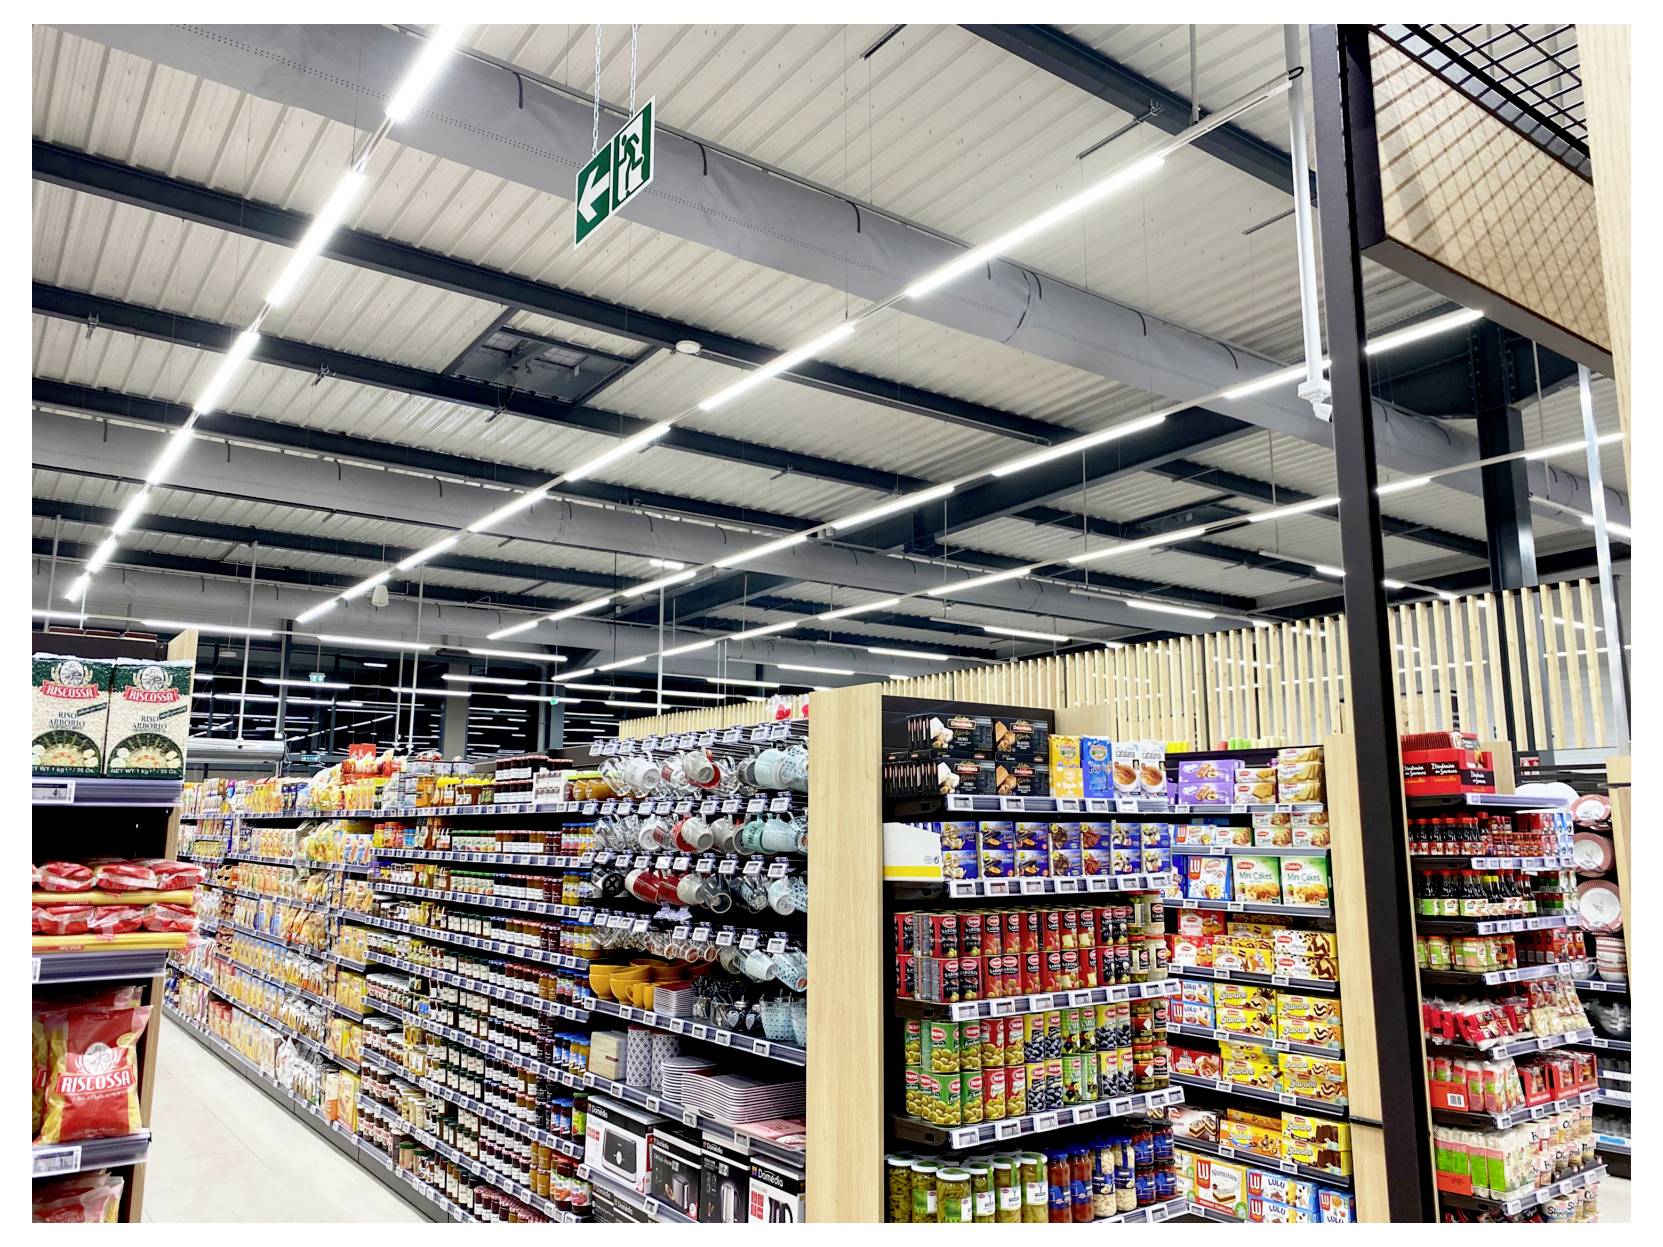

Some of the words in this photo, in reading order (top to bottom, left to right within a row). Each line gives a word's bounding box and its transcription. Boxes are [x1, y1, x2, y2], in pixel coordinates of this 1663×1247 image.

[46, 685, 94, 699] RISCOSSA
[129, 690, 175, 702] RISCOSSA
[58, 711, 78, 719] RISO
[140, 715, 160, 723] RISO
[49, 718, 86, 728] ARBORIO
[132, 722, 168, 730] ARBORIO
[1190, 859, 1200, 873] LU
[1253, 872, 1273, 880] Cakes
[1301, 873, 1321, 882] Cakes
[1173, 1005, 1182, 1017] LU
[60, 1070, 131, 1093] RISCOSSA
[1289, 1079, 1317, 1089] Savane
[1197, 1161, 1209, 1180] LU
[1249, 1174, 1260, 1190] LU
[1267, 1178, 1286, 1189] LULU
[1321, 1193, 1330, 1207] LU
[1250, 1200, 1261, 1216] LU
[1268, 1204, 1286, 1216] LULU
